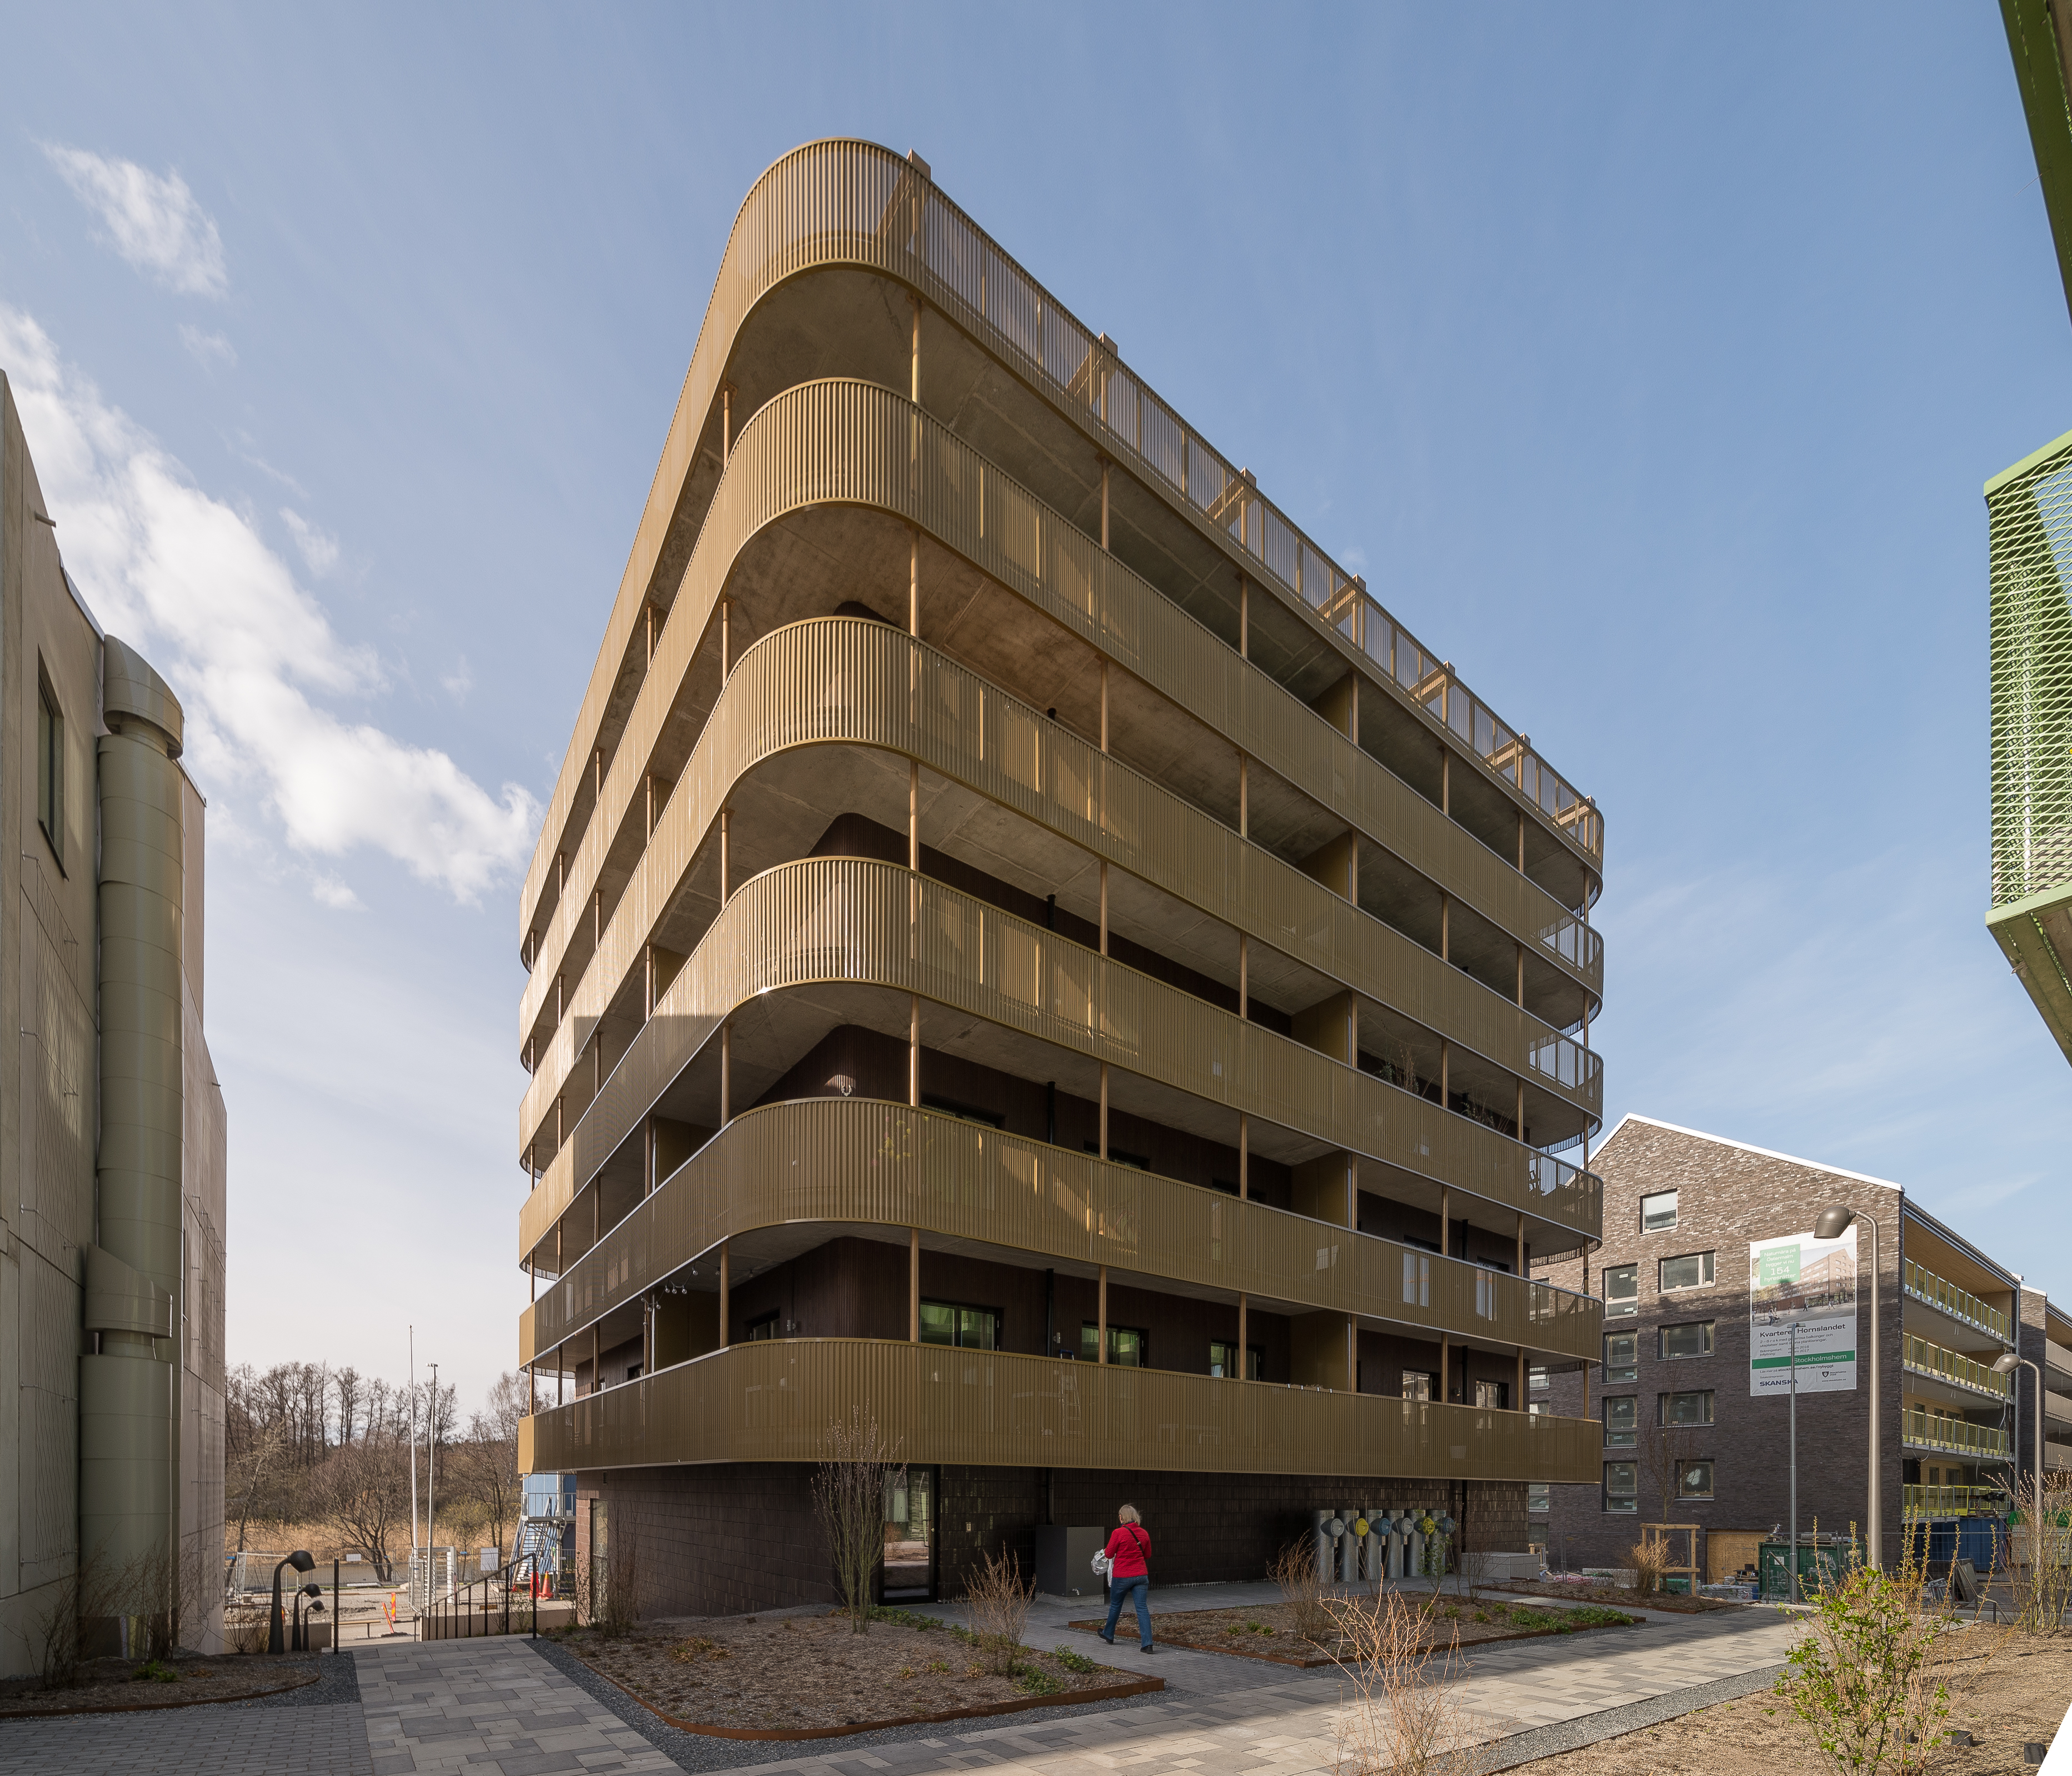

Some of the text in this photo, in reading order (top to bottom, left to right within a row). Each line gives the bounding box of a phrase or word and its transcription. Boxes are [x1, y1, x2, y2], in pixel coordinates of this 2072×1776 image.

[1771, 1266, 1790, 1275] 154
[1764, 1274, 1796, 1282] hyresrätter
[1797, 1324, 1846, 1334] Hornslandet
[1794, 1355, 1847, 1363] Stockholmshem
